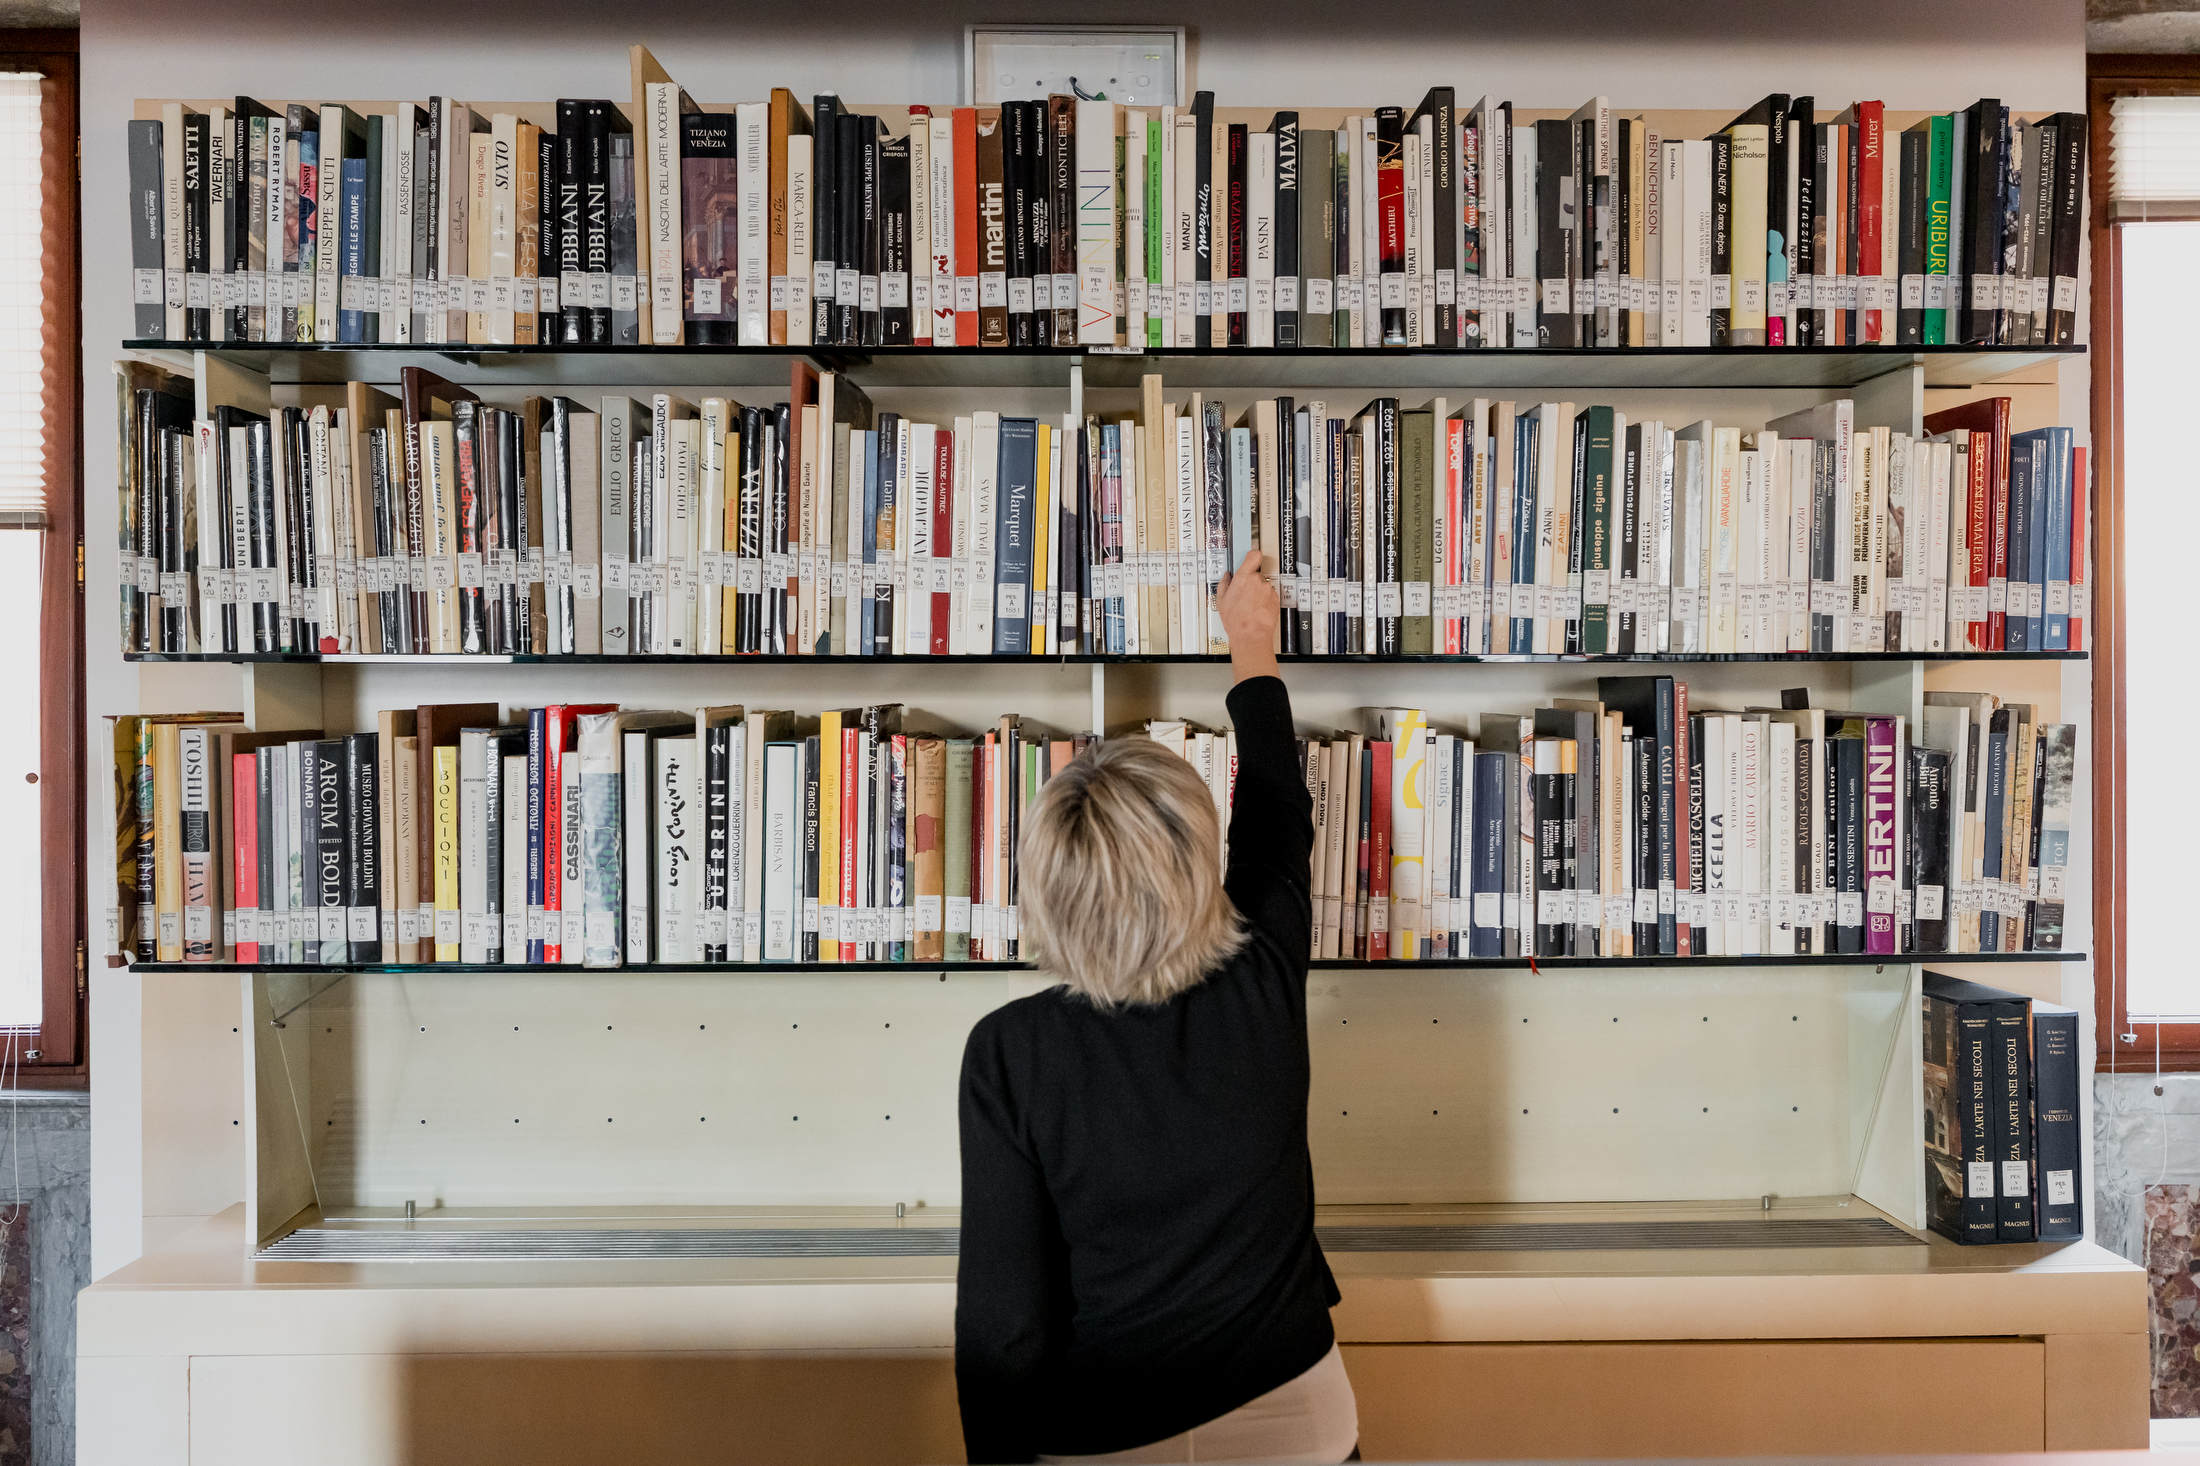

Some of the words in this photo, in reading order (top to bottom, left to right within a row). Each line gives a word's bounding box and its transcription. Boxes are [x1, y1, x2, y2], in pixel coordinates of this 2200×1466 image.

[657, 87, 667, 139] MODERNA
[1775, 111, 1784, 144] Nespolo
[186, 126, 199, 189] SAETTI
[659, 142, 668, 168] ARTE
[1058, 114, 1068, 189] MONTICELLI
[1280, 121, 1296, 190] MALVA
[1649, 134, 1657, 158] BEN
[1718, 143, 1727, 172] ISMAEL
[1865, 118, 1878, 158] Murer
[2042, 131, 2050, 164] SPALLE
[2070, 142, 2078, 170] corps
[212, 136, 222, 204] TAVERNARI
[476, 146, 486, 170] Diego
[495, 141, 508, 189] SIXTO
[323, 157, 335, 201] SCIUTI
[400, 151, 410, 215] RASSENFOSSE
[429, 184, 436, 192] de
[541, 143, 552, 214] Impressionismo
[1718, 174, 1726, 195] NERY
[2069, 174, 2076, 184] au
[428, 195, 436, 234] empreintes
[794, 172, 804, 255] MARCA-RELLI
[1649, 162, 1657, 235] NICHOLSON
[1718, 203, 1726, 213] 50
[2040, 189, 2048, 224] FUTURO
[2067, 188, 2075, 214] L'âme
[544, 220, 552, 256] italiano
[660, 198, 670, 242] NASCITA
[980, 183, 1003, 265] martini
[1182, 212, 1191, 250] MANZU'
[1258, 216, 1269, 259] PASINI
[1802, 178, 1812, 259] Pedrazzini
[2039, 226, 2046, 235] IL
[322, 208, 335, 271] GIUSEPPE
[1717, 232, 1726, 255] depois
[818, 302, 827, 336] MESSINA
[610, 418, 621, 462] GRECO
[1384, 408, 1393, 433] 1993
[678, 441, 687, 480] PAOLO
[1350, 456, 1360, 485] SEPPI
[1450, 433, 1460, 470] TOPOR
[610, 471, 621, 516] EMILIO
[938, 446, 947, 514] TOULOUSE-LAUTREC
[980, 478, 990, 514] MAAS
[1385, 471, 1394, 502] inciso
[1593, 474, 1604, 513] zigaina
[1626, 451, 1635, 543] SOCHY/SCULPTURES
[676, 485, 686, 519] GIOLI
[1005, 484, 1026, 548] Marquet
[1350, 491, 1360, 549] CESARINA
[1385, 504, 1394, 536] Diario
[236, 506, 246, 566] UNIBERTI
[803, 519, 811, 548] xilografie
[979, 520, 988, 550] PAUL
[1592, 519, 1603, 569] giuseppe
[304, 751, 313, 808] BONNARD
[362, 764, 372, 797] MUSEO
[1642, 752, 1650, 792] Alexander
[1662, 745, 1672, 785] CAGLI
[1745, 733, 1756, 798] CARRARO
[1920, 766, 1930, 787] Bini
[807, 782, 817, 816] Francis
[1436, 763, 1450, 808] Signac
[1692, 763, 1702, 830] CASCELLA
[1929, 766, 1940, 809] Antonio
[362, 799, 373, 845] GIOVANNI
[1642, 795, 1650, 821] Calder
[1660, 790, 1670, 821] disegni
[566, 785, 578, 881] CASSINARI
[774, 813, 783, 872] BARBISAN
[807, 820, 816, 851] Bacon
[1746, 804, 1756, 848] MARIO
[1662, 842, 1670, 850] la
[1691, 833, 1703, 892] MICHELE
[362, 849, 374, 888] BOLDINI
[1973, 1040, 1982, 1078] SECOLI
[2008, 1038, 2016, 1075] SECOLI
[1974, 1081, 1983, 1099] NEI
[2009, 1079, 2017, 1097] NEI
[1974, 1102, 1984, 1138] L'ARTE
[2009, 1100, 2019, 1136] L'ARTE
